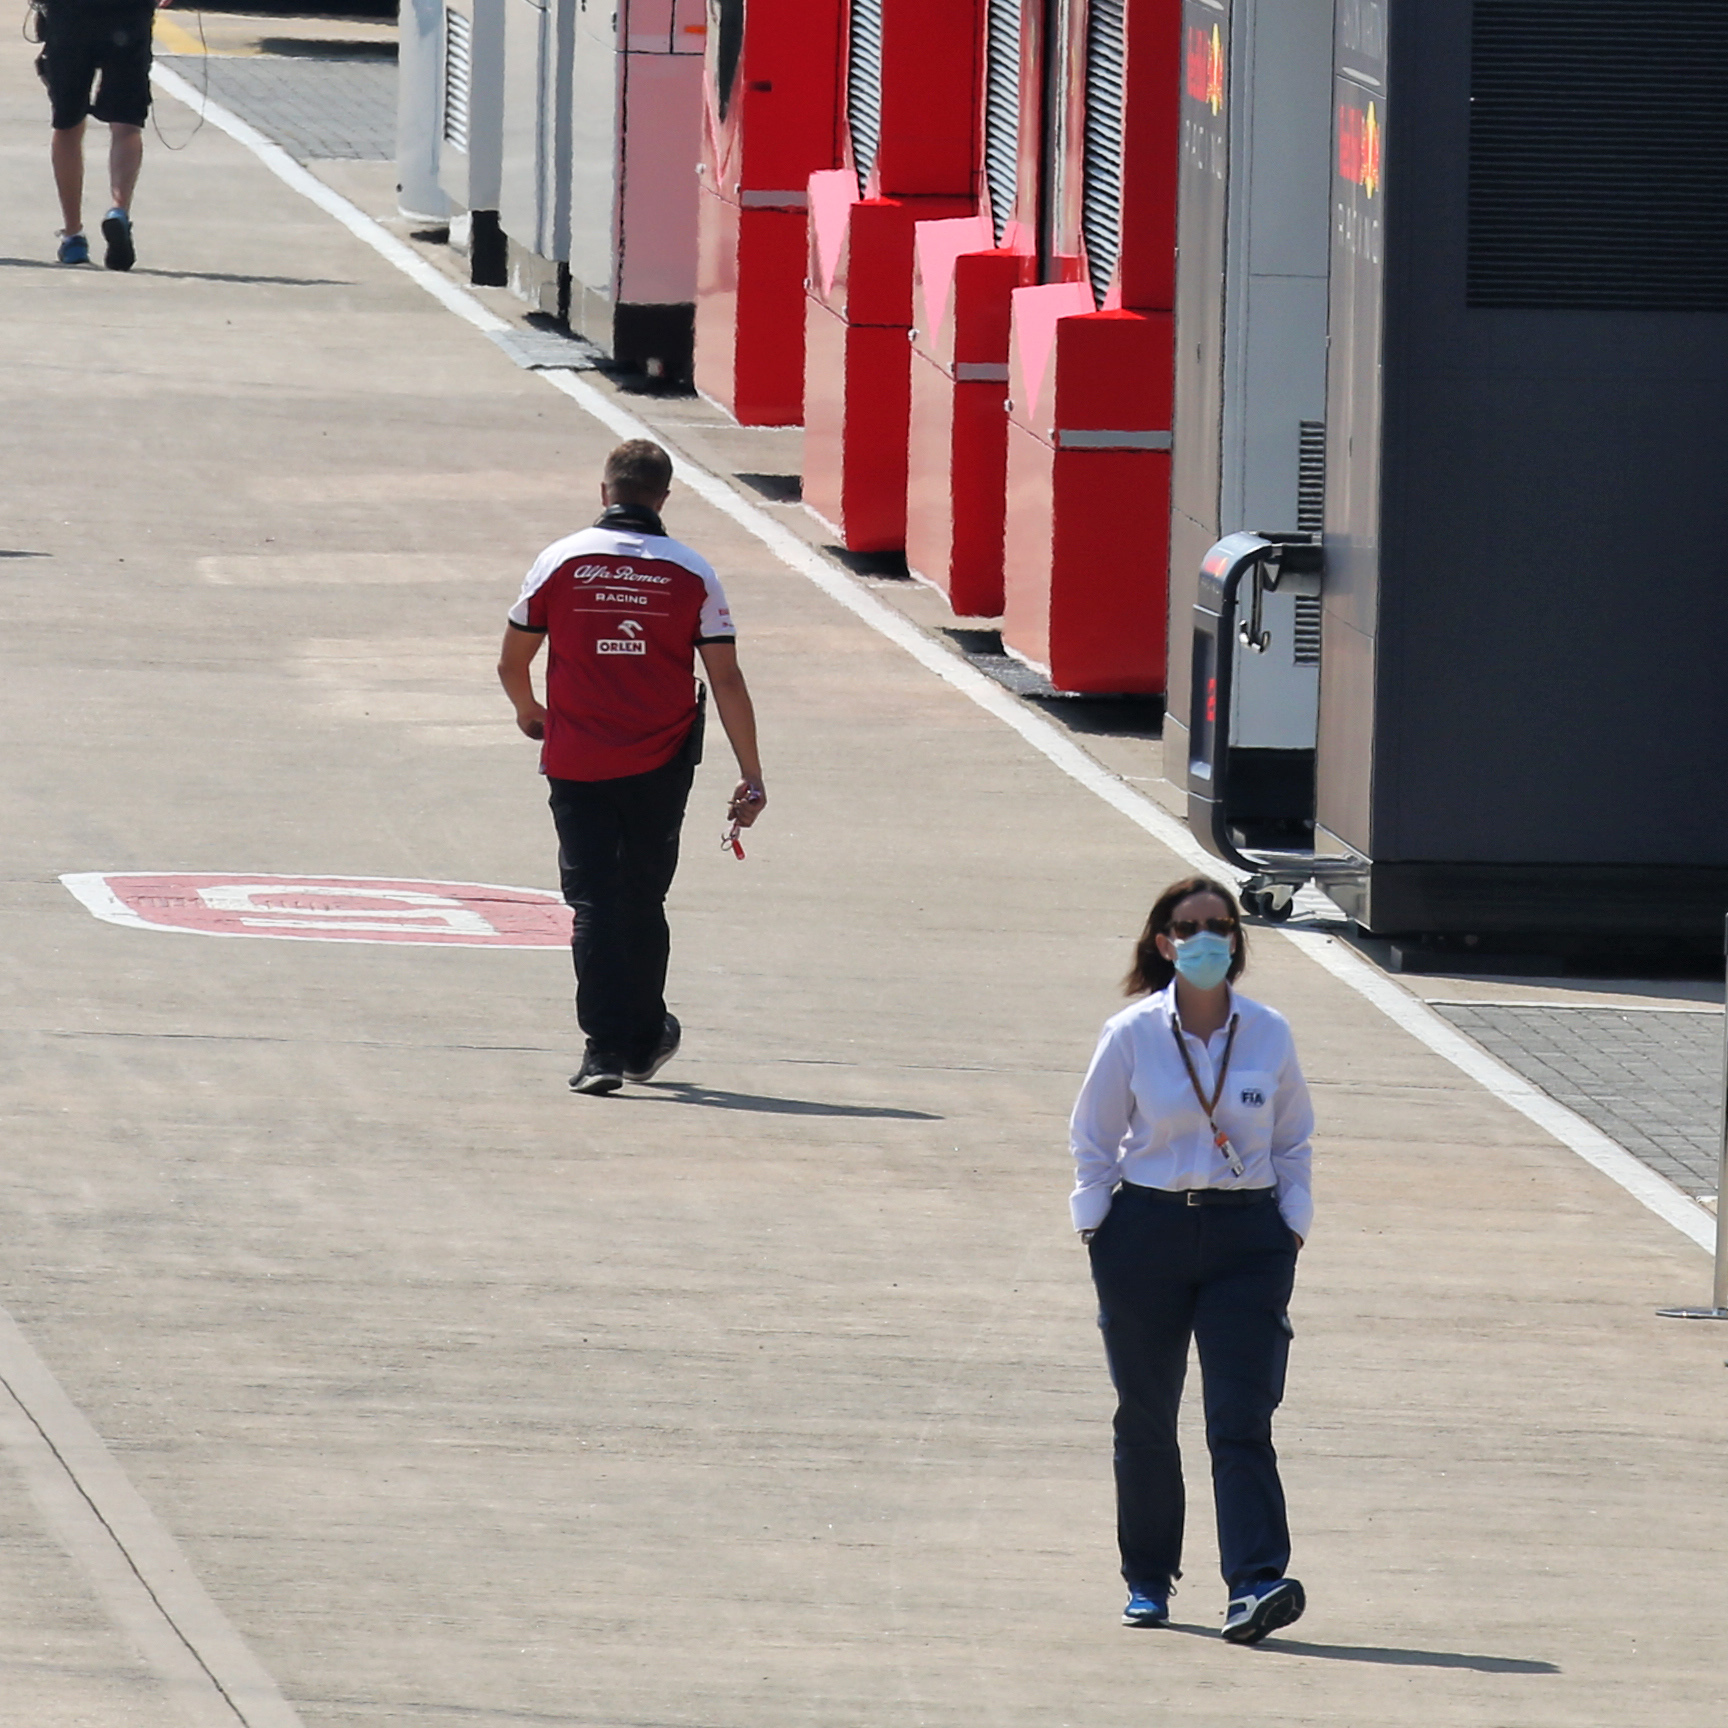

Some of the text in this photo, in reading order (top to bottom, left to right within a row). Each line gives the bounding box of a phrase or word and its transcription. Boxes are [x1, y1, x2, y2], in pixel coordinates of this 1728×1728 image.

[574, 564, 672, 585] Alfa Romeo
[595, 592, 648, 605] RACING
[599, 641, 643, 653] ORLEN
[1241, 1091, 1265, 1105] FIA
